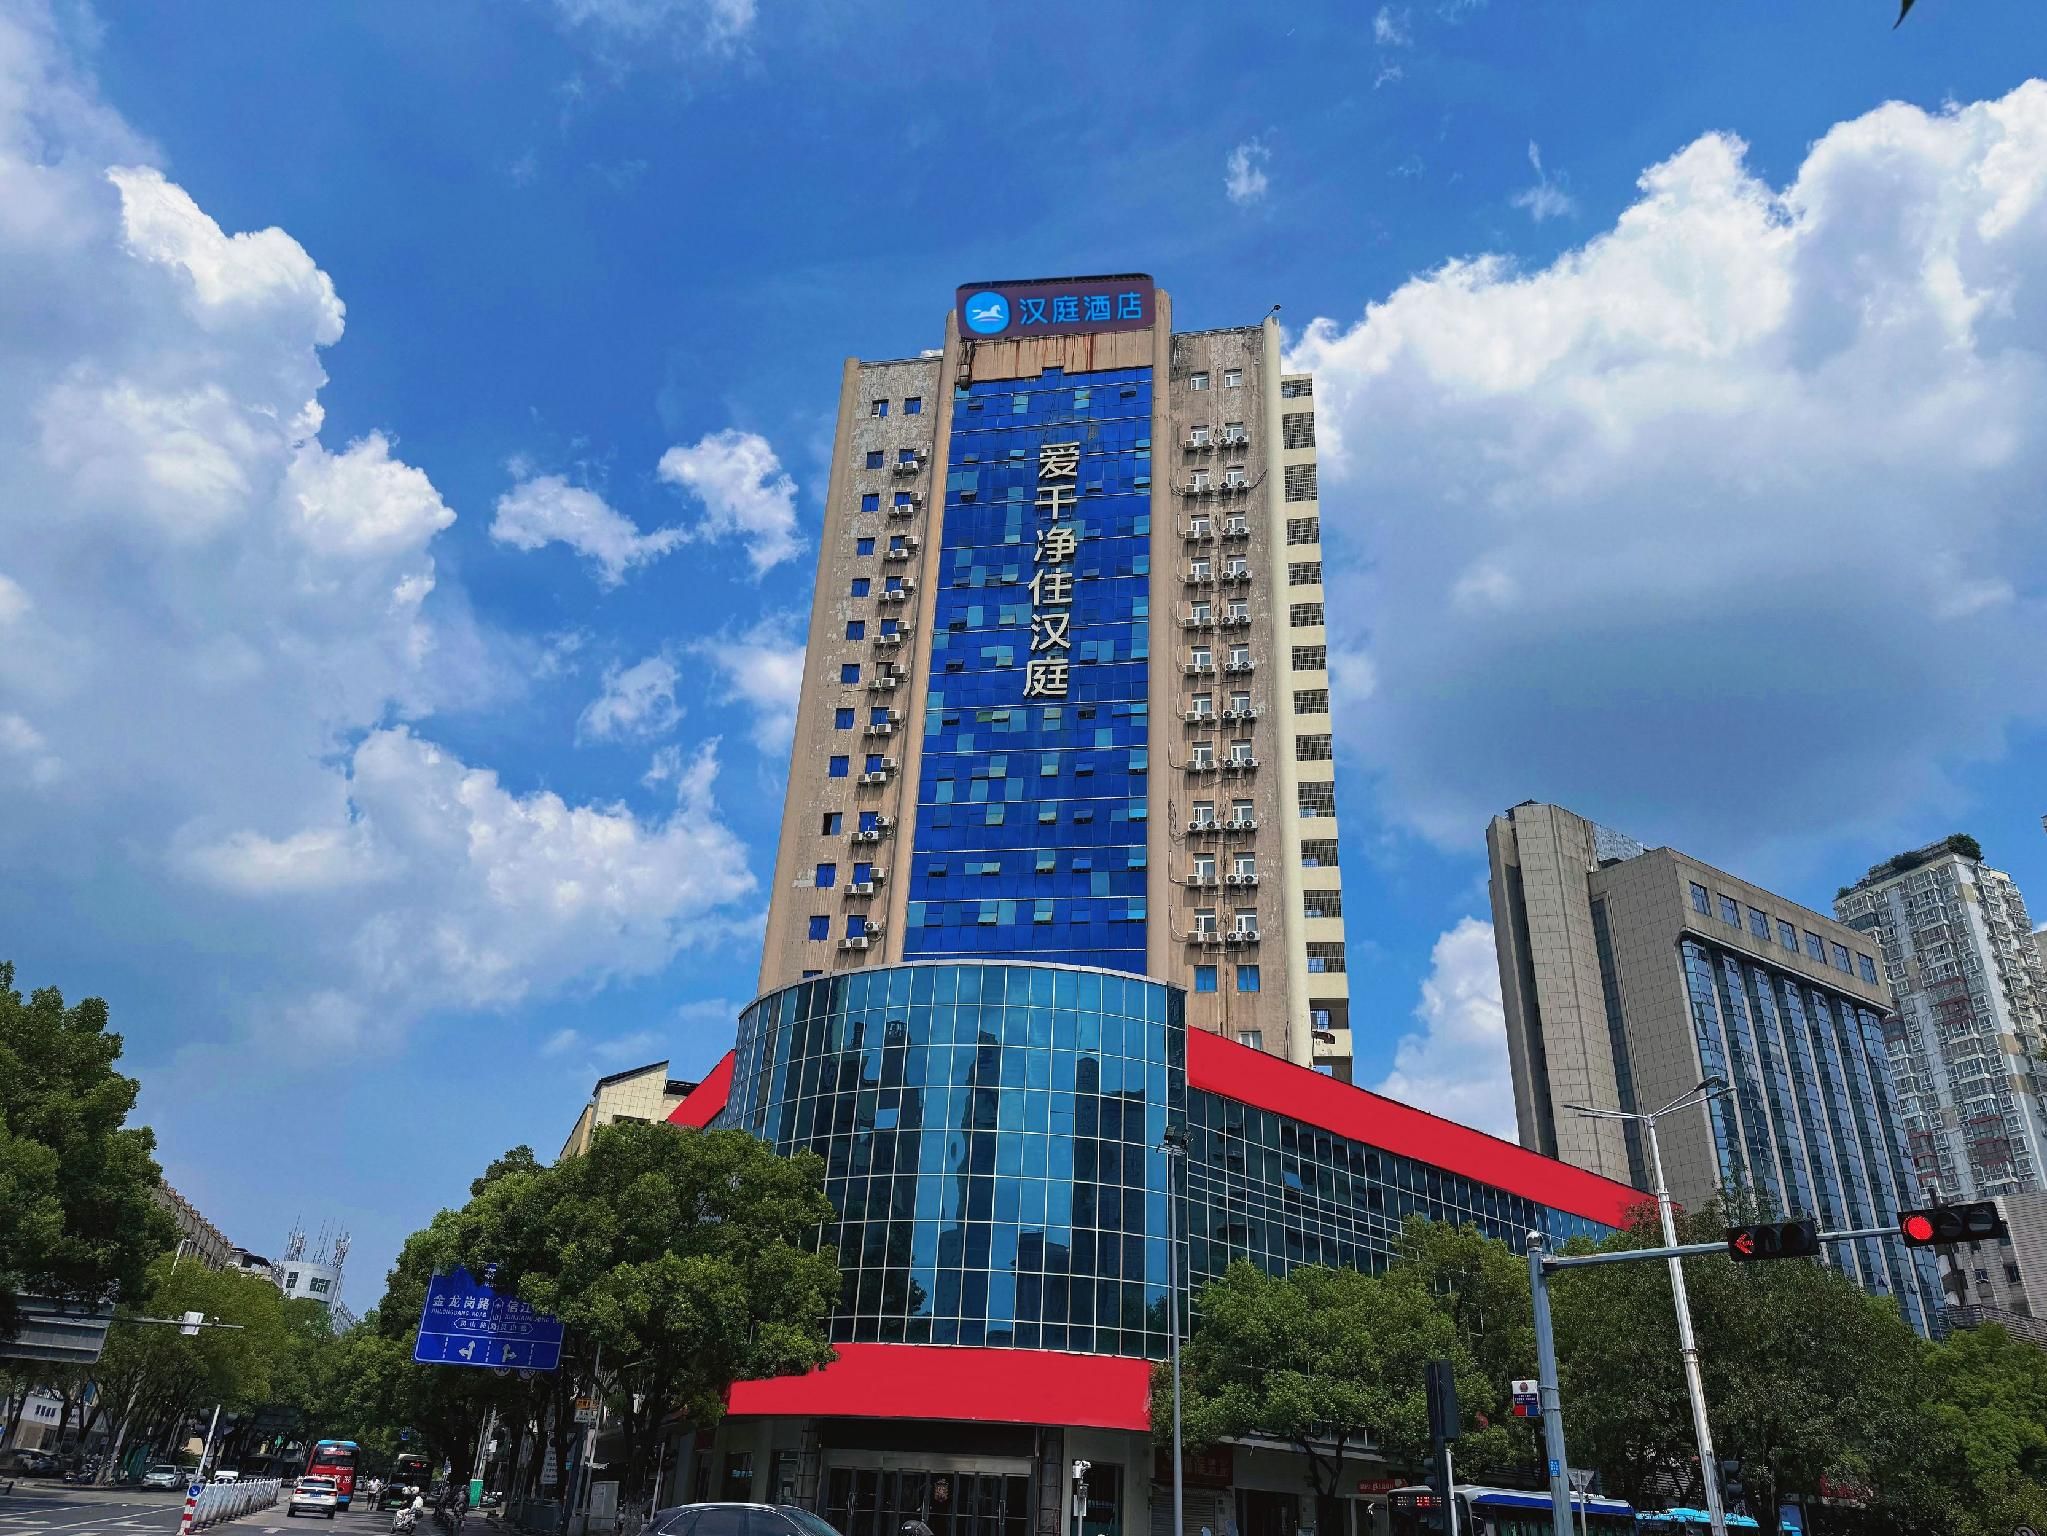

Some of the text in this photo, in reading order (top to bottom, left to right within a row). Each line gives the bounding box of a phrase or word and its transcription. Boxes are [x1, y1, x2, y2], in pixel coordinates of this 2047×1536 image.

[1018, 291, 1143, 325] 汉庭酒店
[1023, 441, 1081, 697] 爱干净住汉庭
[432, 1294, 490, 1310] 金龙岗路
[507, 1299, 534, 1313] 信江
